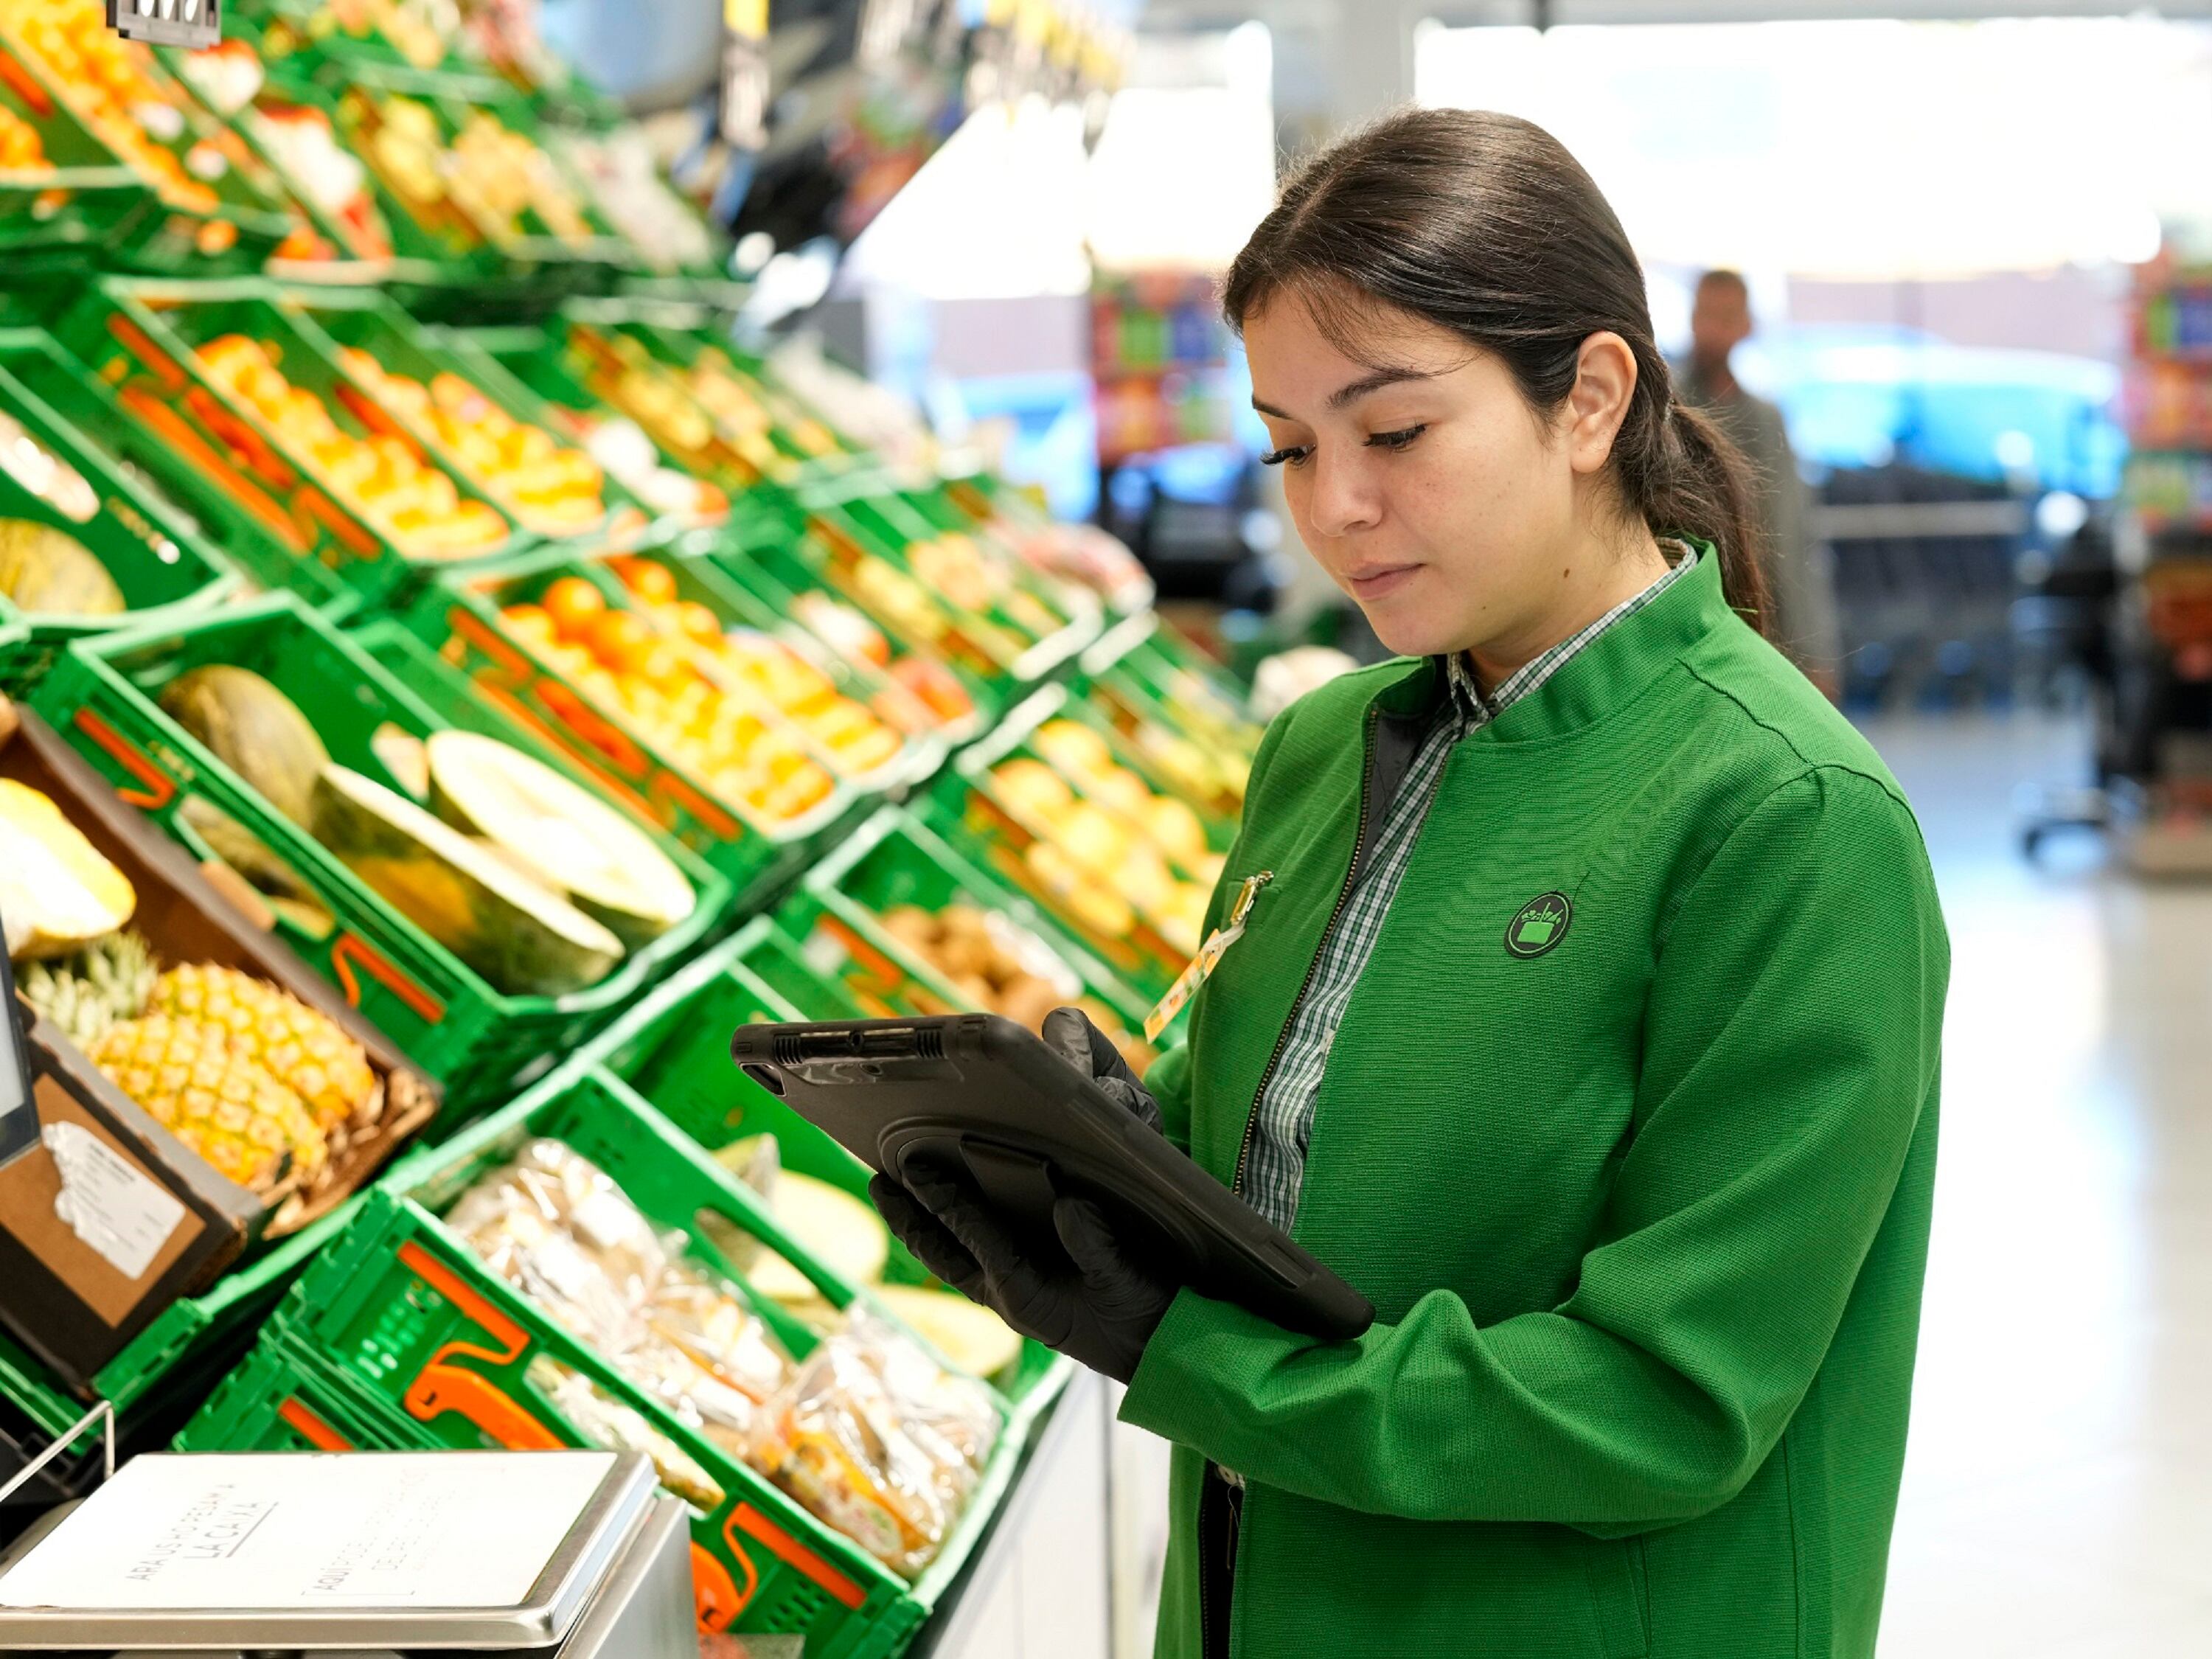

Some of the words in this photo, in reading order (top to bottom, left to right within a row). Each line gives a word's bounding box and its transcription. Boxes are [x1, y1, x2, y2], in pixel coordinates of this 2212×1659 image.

[204, 1502, 266, 1538] CAIXA
[125, 1558, 168, 1581] ARA
[147, 1543, 182, 1556] US
[183, 1543, 229, 1559] LA
